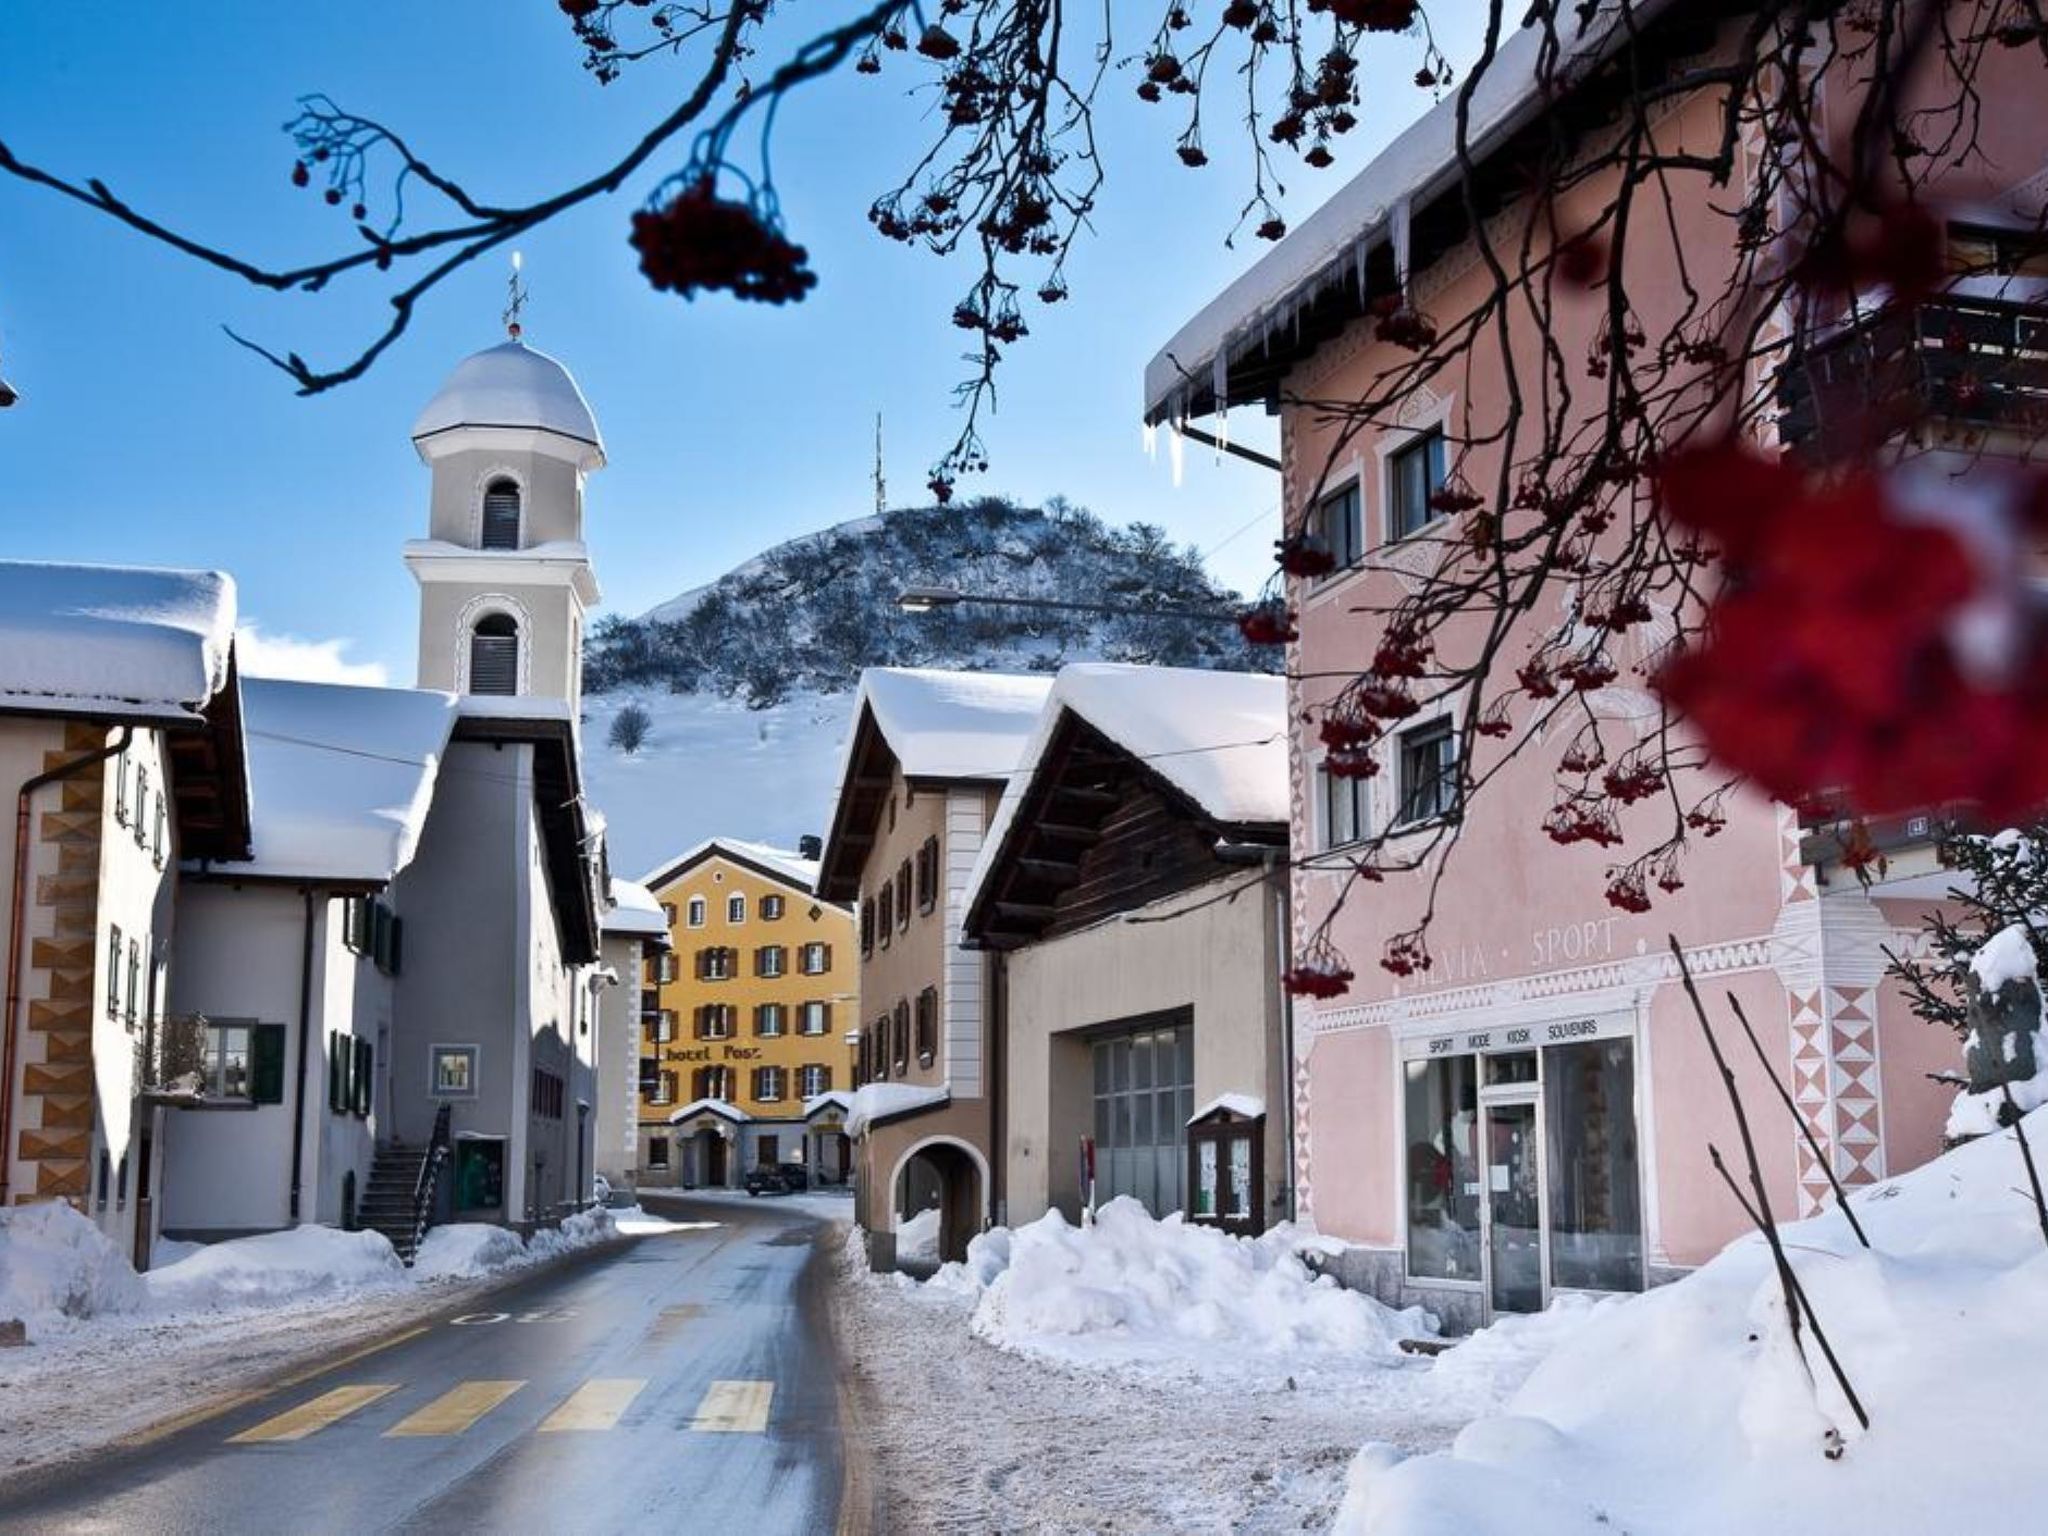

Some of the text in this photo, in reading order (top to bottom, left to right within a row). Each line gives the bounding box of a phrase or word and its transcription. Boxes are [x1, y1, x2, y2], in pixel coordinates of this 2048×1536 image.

[1532, 917, 1618, 966] SPORT
[1429, 1019, 1597, 1053] SPORT MODE KIOSK SOUVENIRS
[667, 1046, 710, 1061] hotel
